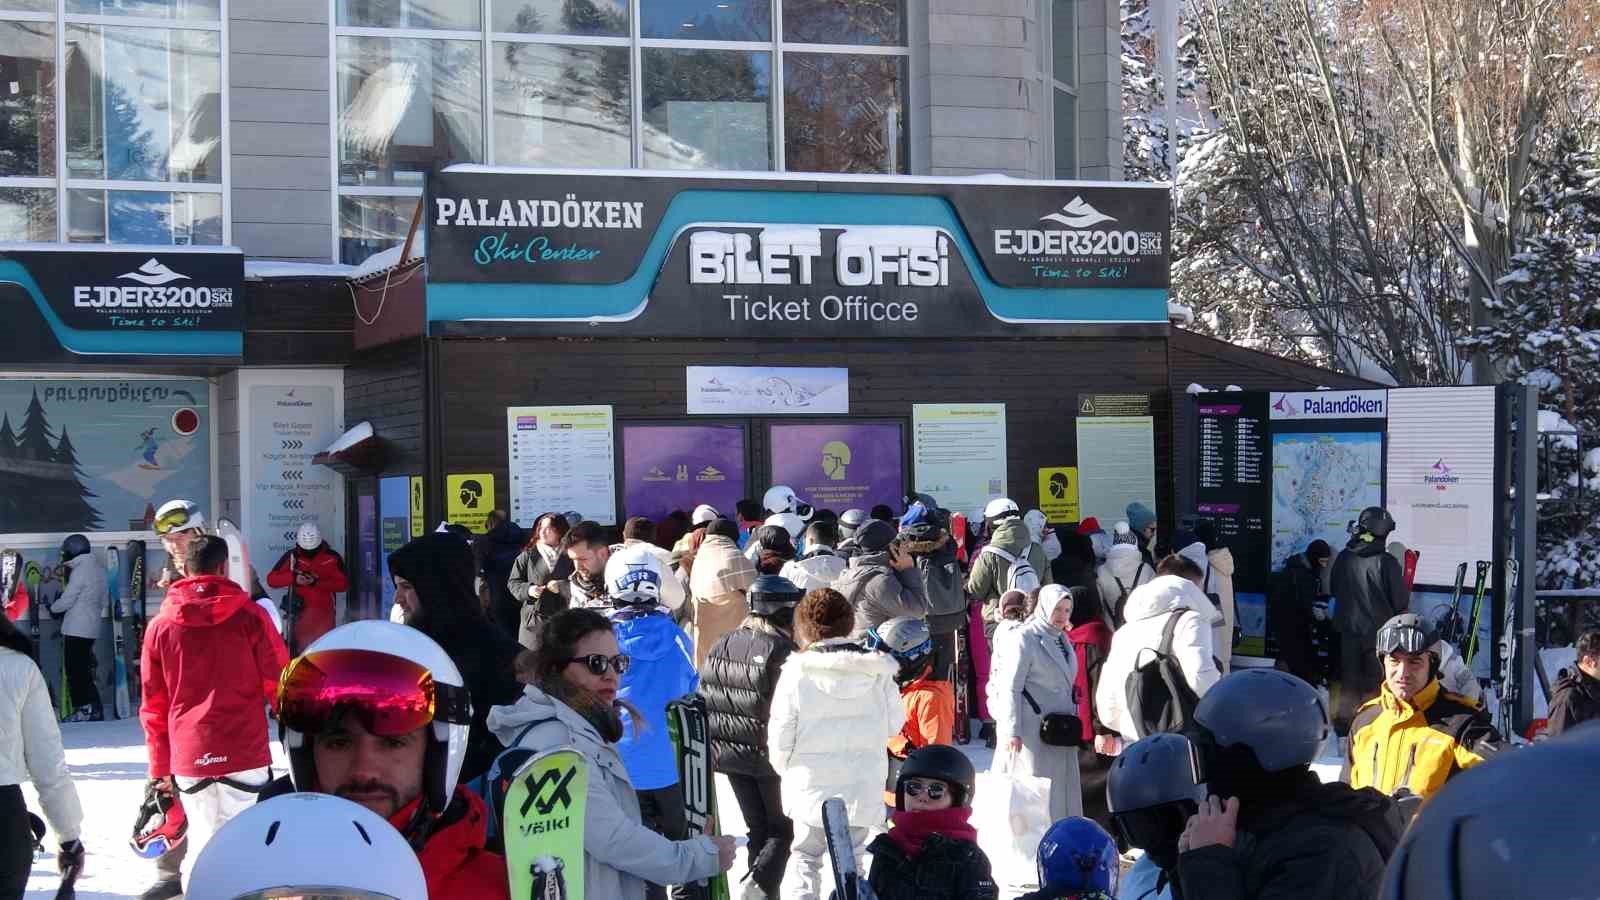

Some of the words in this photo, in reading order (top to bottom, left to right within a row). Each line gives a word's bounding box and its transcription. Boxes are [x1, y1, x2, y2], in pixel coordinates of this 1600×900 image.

[436, 194, 644, 229] PALANDÖKEN
[474, 232, 524, 265] Ski
[525, 236, 601, 263] Center
[994, 229, 1139, 255] EJDER3200
[1140, 238, 1162, 250] SKI
[1076, 267, 1093, 278] to
[73, 286, 211, 308] EJDER3200
[212, 292, 233, 303] SKI
[722, 295, 811, 321] Ticket
[820, 294, 919, 321] Officce
[151, 317, 168, 326] to
[1303, 394, 1383, 414] Palandöken
[519, 815, 570, 837] Völkl
